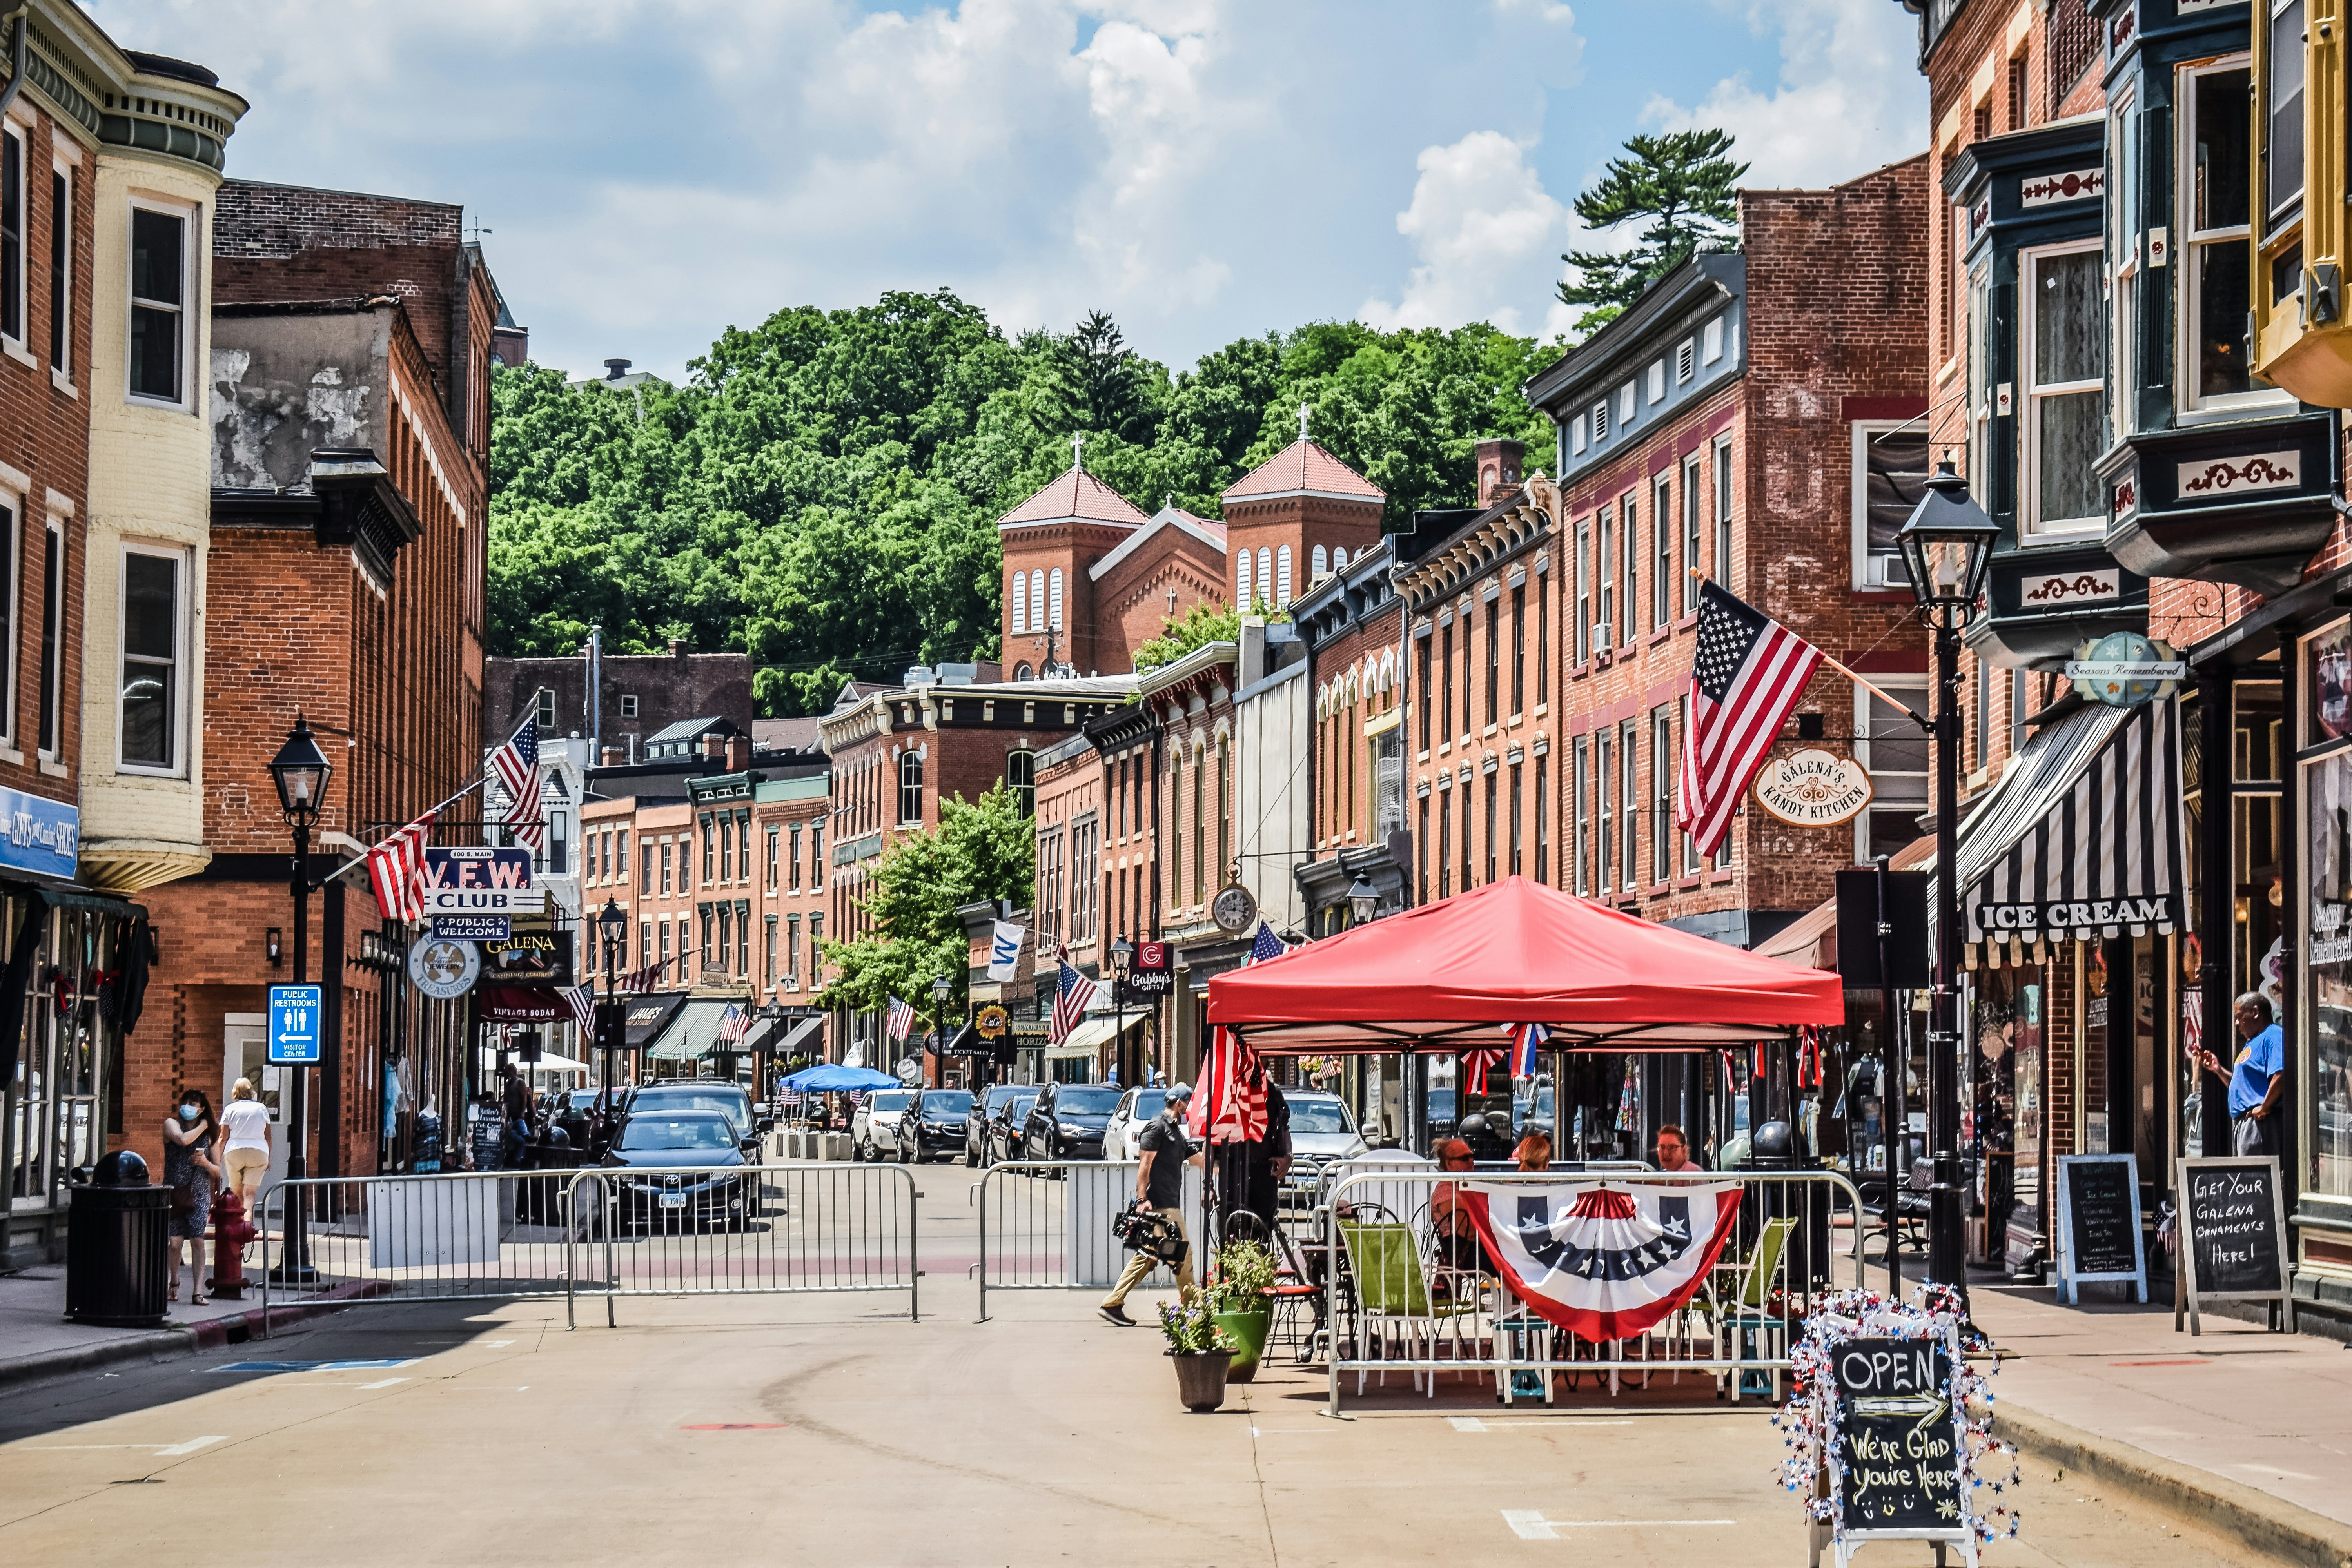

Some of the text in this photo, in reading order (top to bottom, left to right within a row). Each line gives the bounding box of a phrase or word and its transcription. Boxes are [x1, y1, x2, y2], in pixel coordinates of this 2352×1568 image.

[2071, 664, 2182, 675] Seasons Remembered
[1781, 760, 1845, 783] GALENA'S
[1763, 785, 1864, 818] KANDY KITCHEN
[12, 811, 32, 848] GIFTS
[55, 821, 75, 857] SHOES
[437, 893, 508, 908] CLUB
[1983, 898, 2168, 928] ICE CREAM
[486, 936, 556, 953] GALENA
[1143, 945, 1161, 964] G
[416, 974, 471, 996] TREASURES
[1132, 972, 1172, 991] Gabby's
[494, 1008, 526, 1016] VINTAGE
[2195, 1172, 2263, 1198] GET YOUR
[2196, 1203, 2254, 1221] GALENA
[2196, 1221, 2264, 1237] ORNAMENTS
[1843, 1341, 1935, 1390] OPEN
